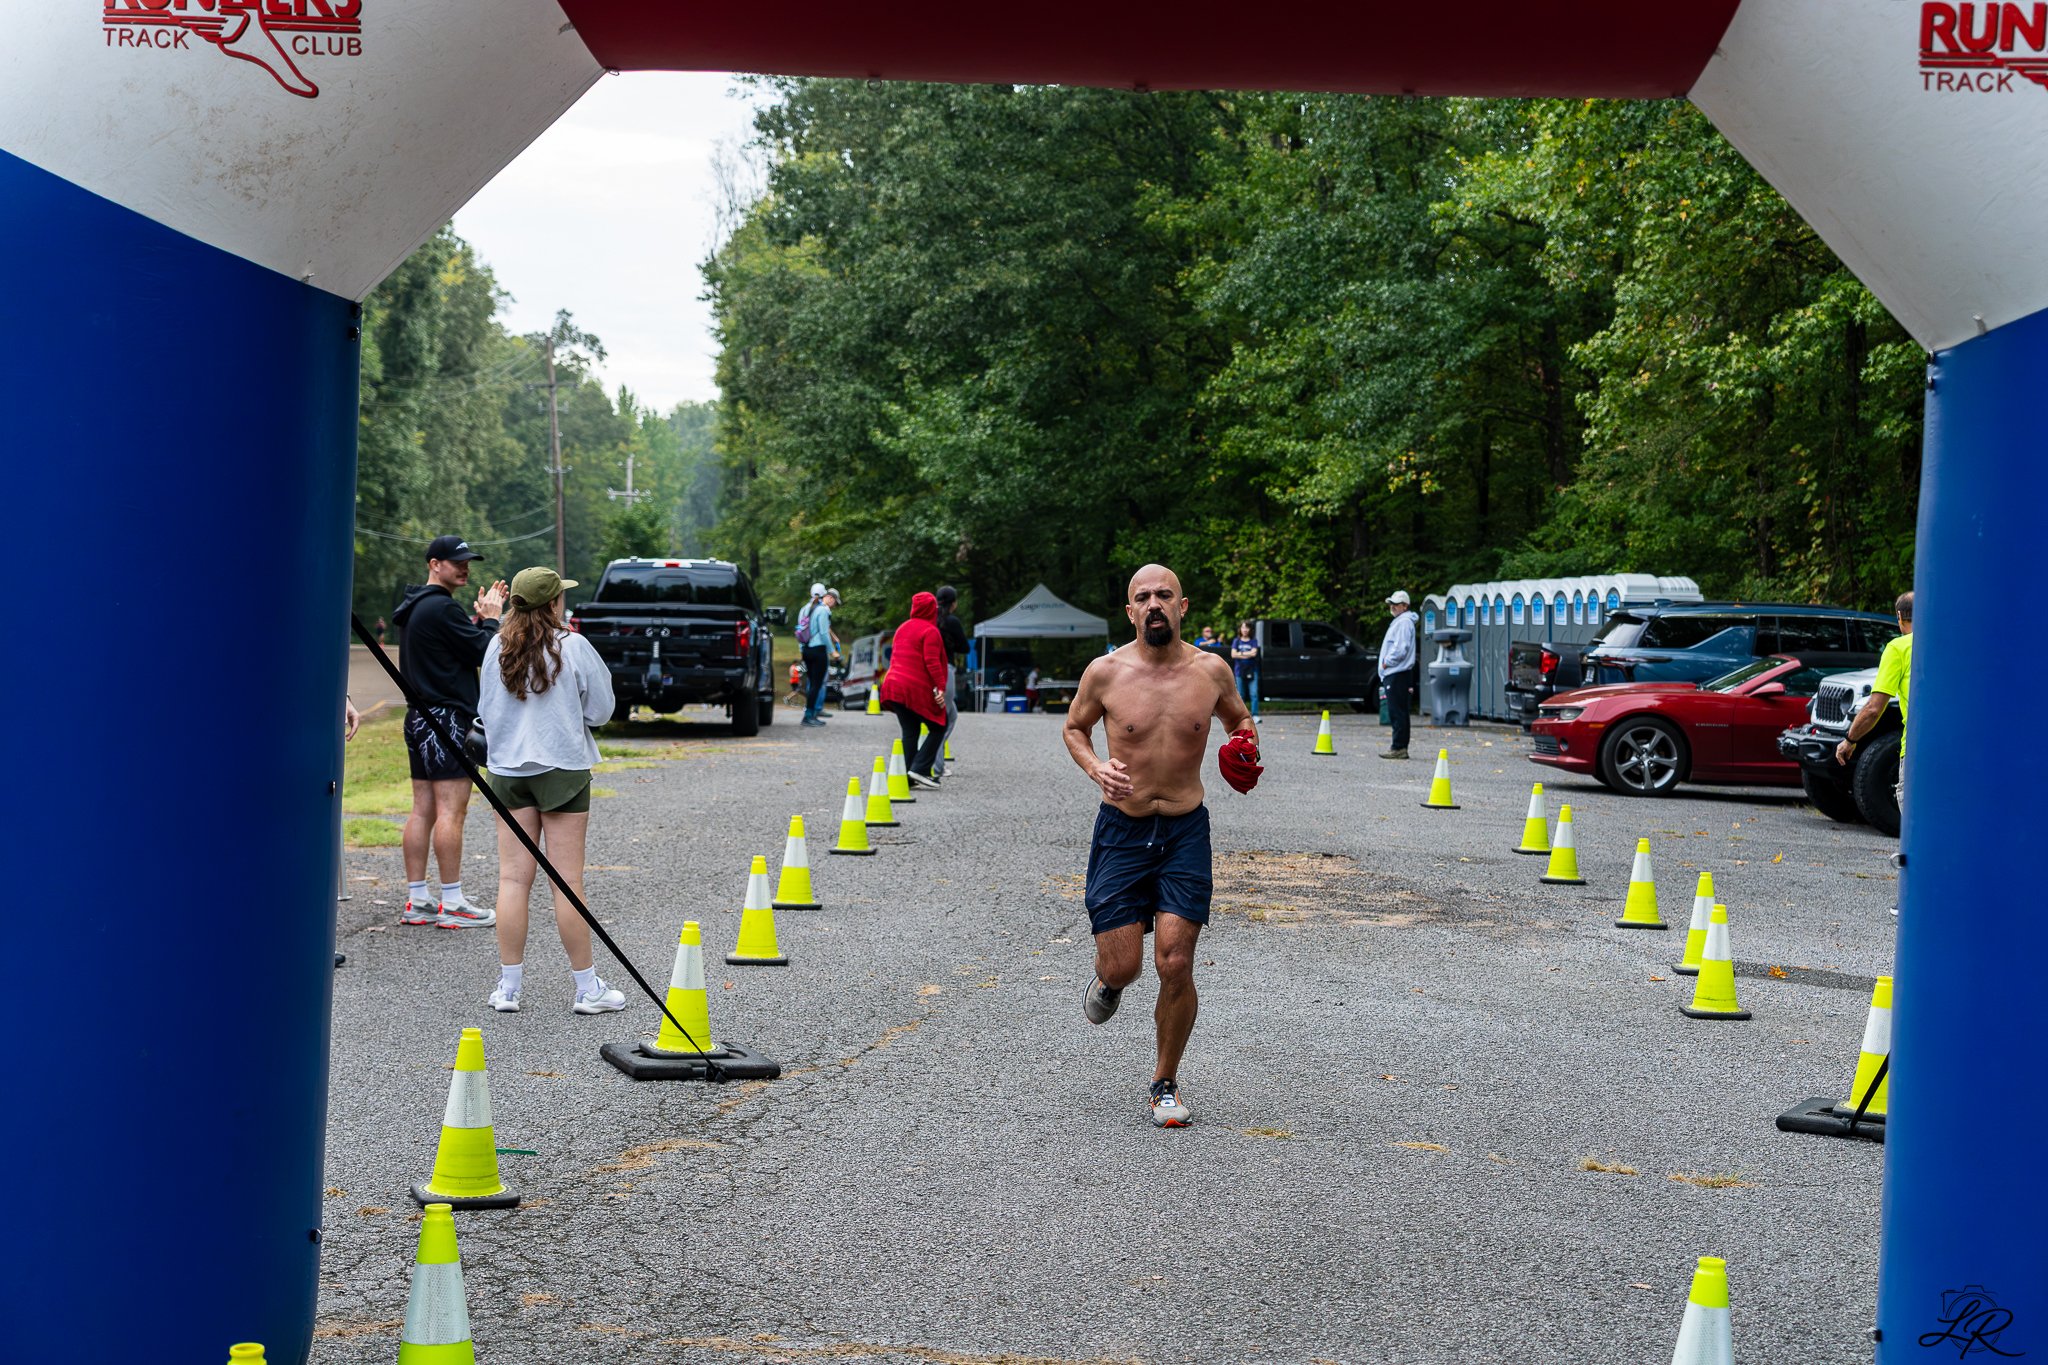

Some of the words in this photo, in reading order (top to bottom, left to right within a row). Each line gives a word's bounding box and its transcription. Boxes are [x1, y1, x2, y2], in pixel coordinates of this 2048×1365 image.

[102, 27, 190, 50] TRACK
[291, 35, 363, 56] CLUB
[1919, 71, 2014, 93] TRACK
